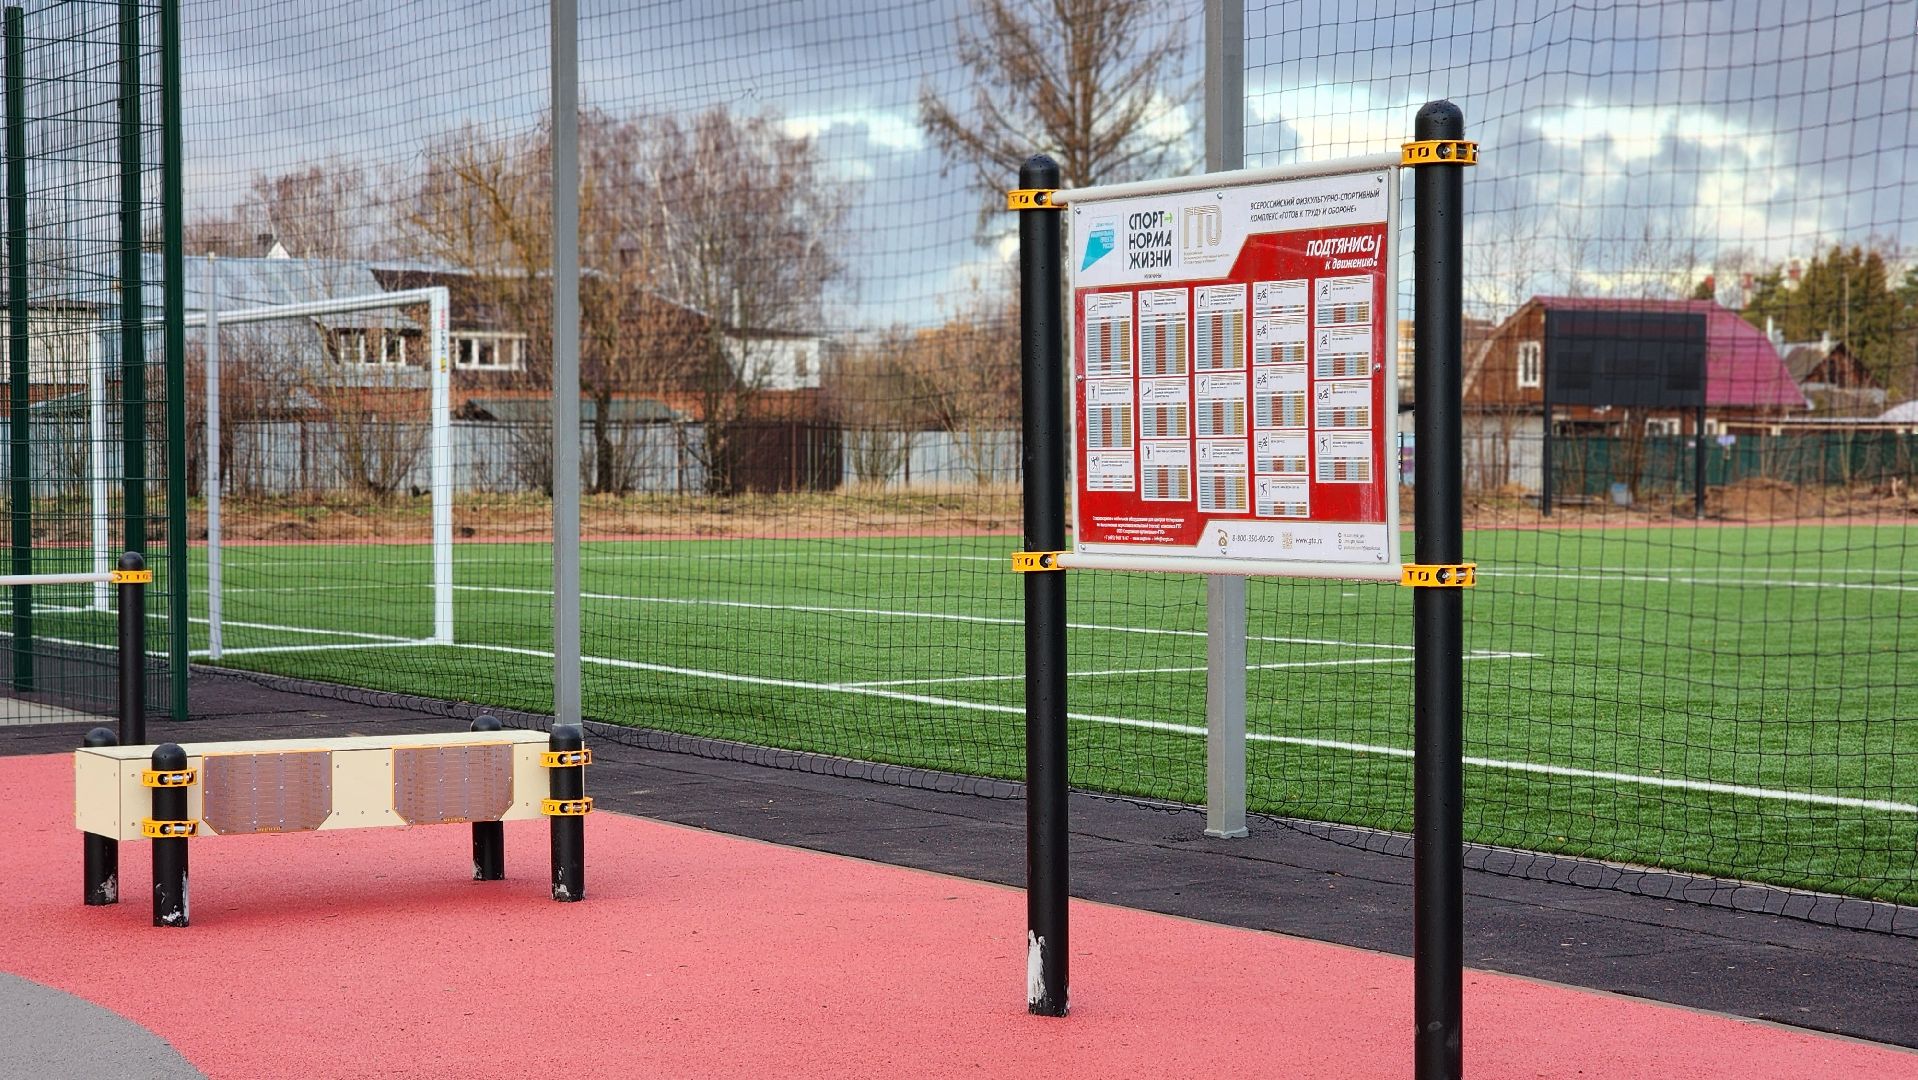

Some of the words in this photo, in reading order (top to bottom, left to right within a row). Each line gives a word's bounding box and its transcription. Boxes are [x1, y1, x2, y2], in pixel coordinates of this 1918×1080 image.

[1250, 197, 1295, 210] ВСЕРОССИЙСКИЙ
[1295, 188, 1380, 207] ФИЗКУЛЬТУРНО-СПОРТИВНЫЙ
[1129, 210, 1165, 230] СПОРТ
[1250, 212, 1278, 222] КОМПЛЕКС
[1305, 207, 1322, 218] ТРУДУ
[1129, 230, 1172, 250] НОРМА
[1129, 249, 1172, 270] ЖИЗНИ
[1332, 257, 1374, 270] движению
